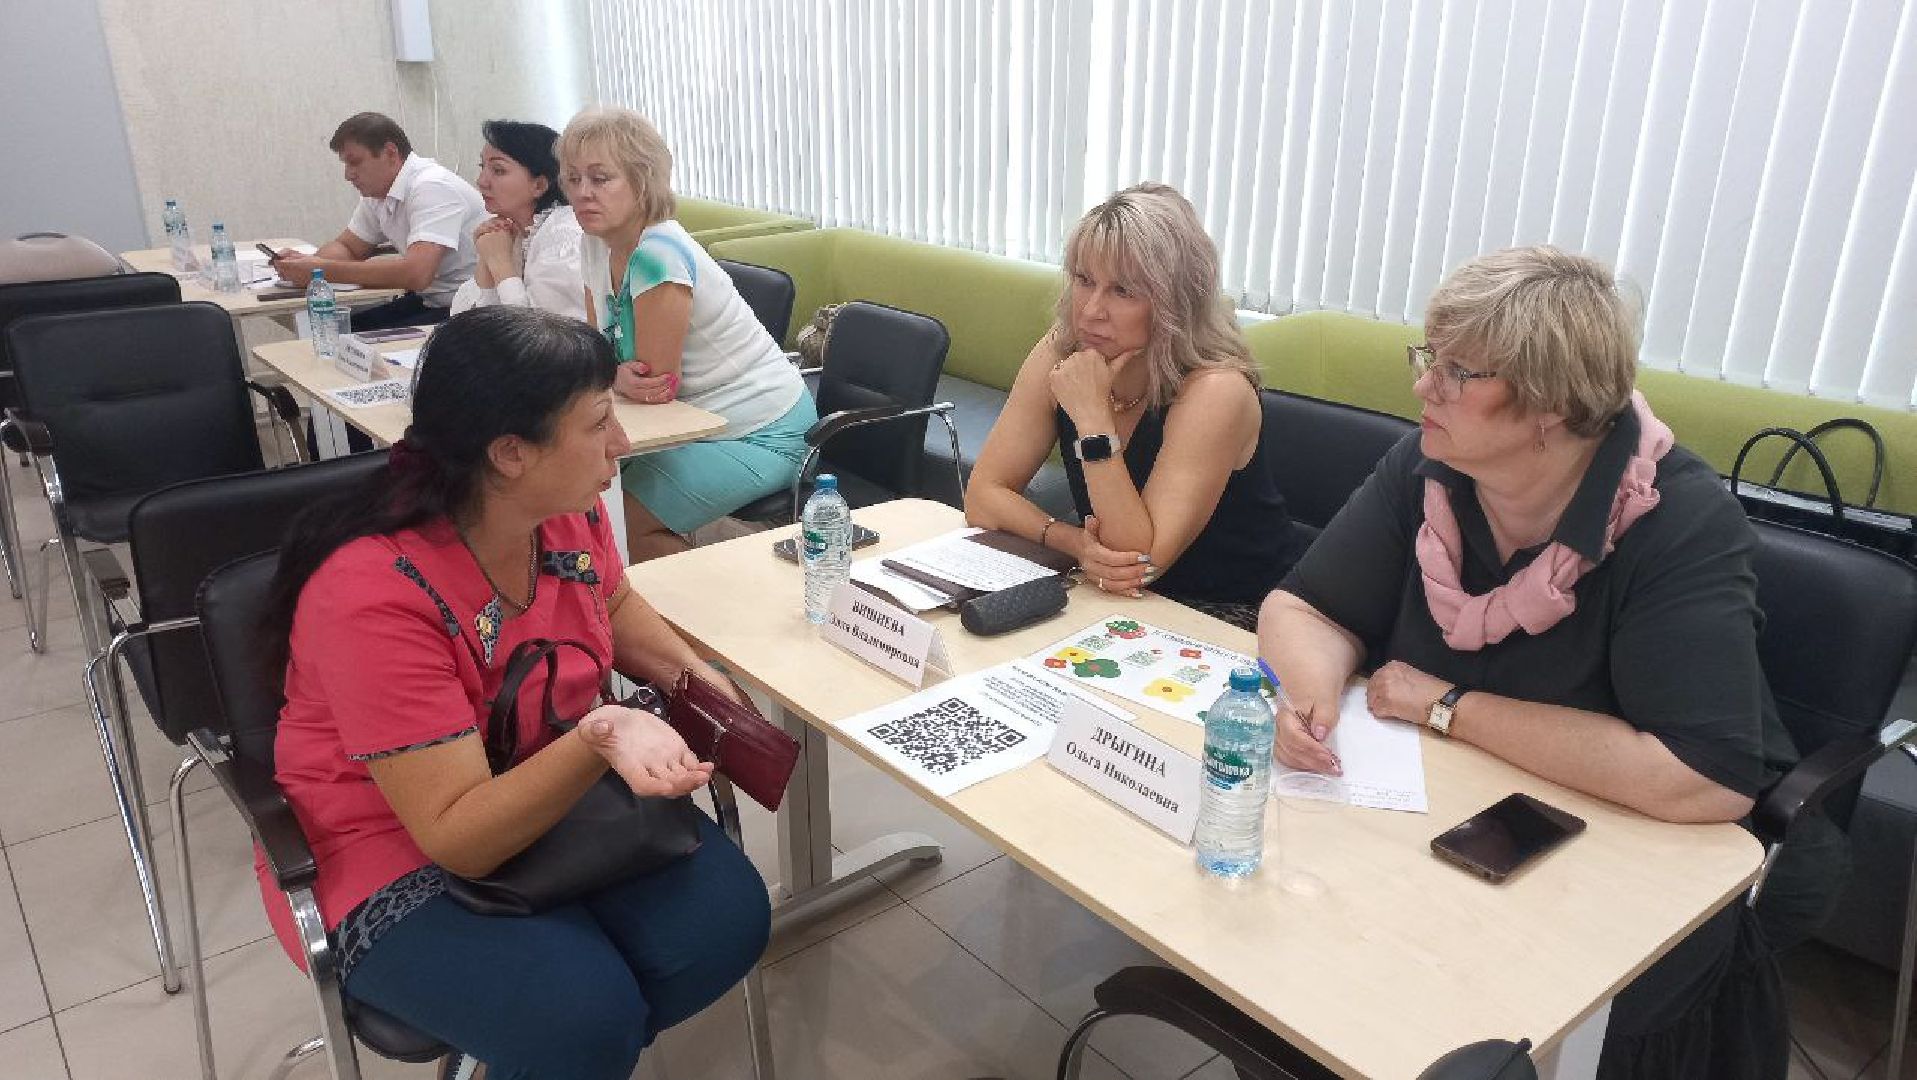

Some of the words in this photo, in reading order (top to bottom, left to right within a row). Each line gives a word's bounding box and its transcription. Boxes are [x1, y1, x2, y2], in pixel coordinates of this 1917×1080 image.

[1066, 741, 1100, 769] Ольга
[1104, 761, 1179, 813] Николаевна
[1090, 726, 1165, 778] ДРЫГИНА
